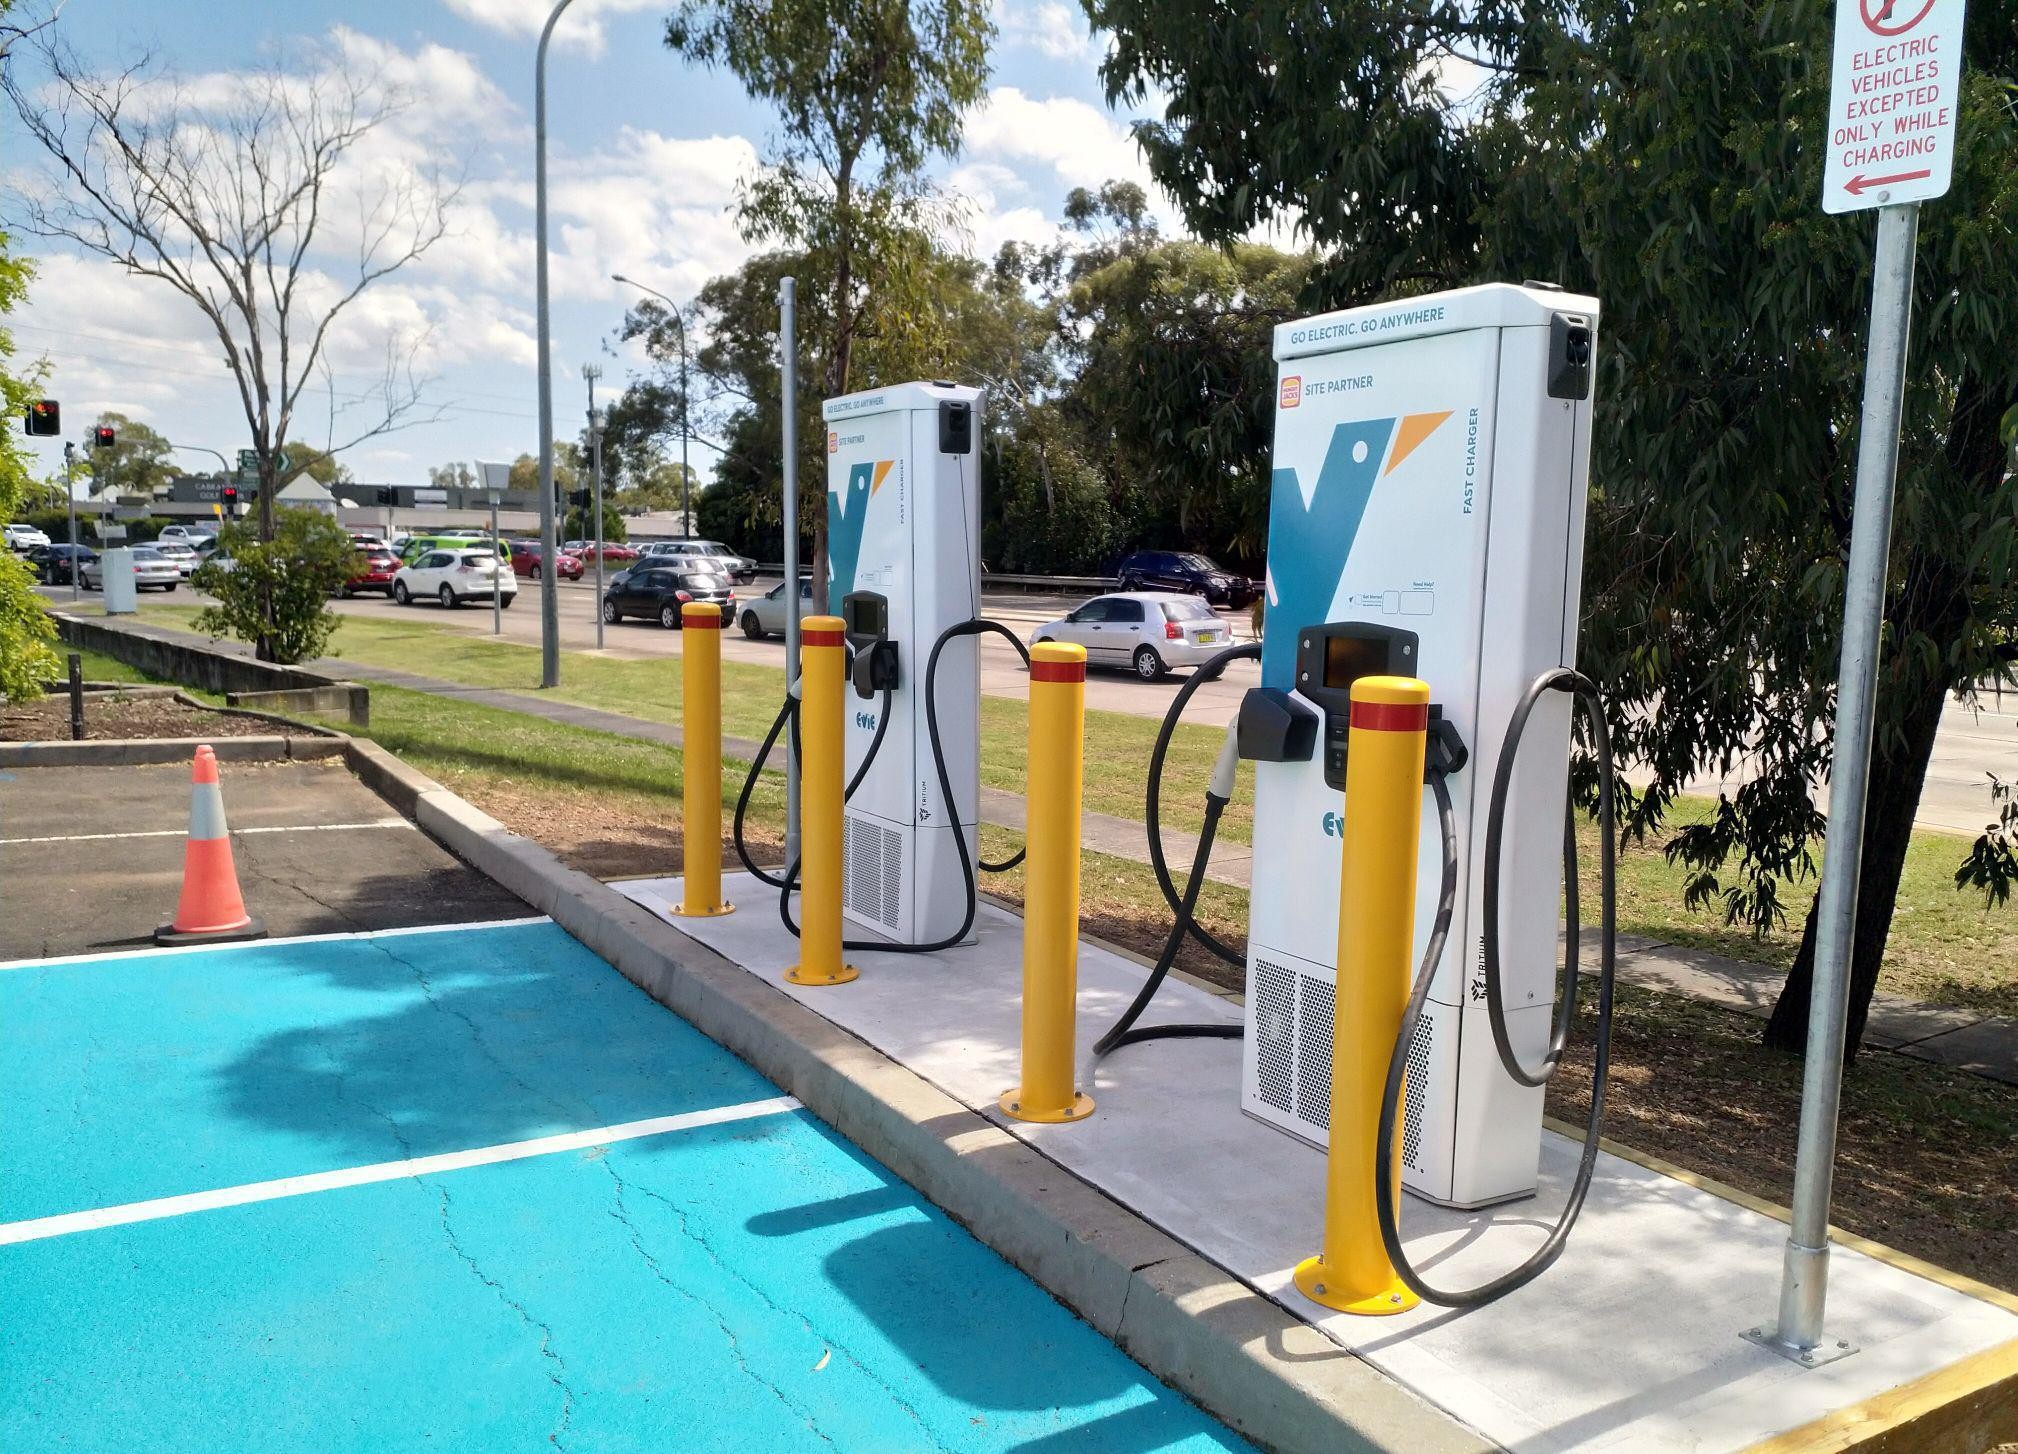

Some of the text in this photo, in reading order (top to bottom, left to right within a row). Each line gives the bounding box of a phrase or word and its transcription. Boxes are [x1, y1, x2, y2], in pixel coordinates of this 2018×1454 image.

[1853, 35, 1939, 70] ELECTRIC
[1852, 60, 1939, 95] VEHICLES
[1847, 85, 1940, 119] EXCEPTED
[1834, 107, 1949, 146] ONLY WHILE
[1843, 135, 1936, 168] CHARGING
[1290, 306, 1445, 344] GO ELECTRIC. GO ANYWHERE
[1305, 375, 1374, 396] SITE PARTNER
[1463, 408, 1478, 515] FAST CHARGER
